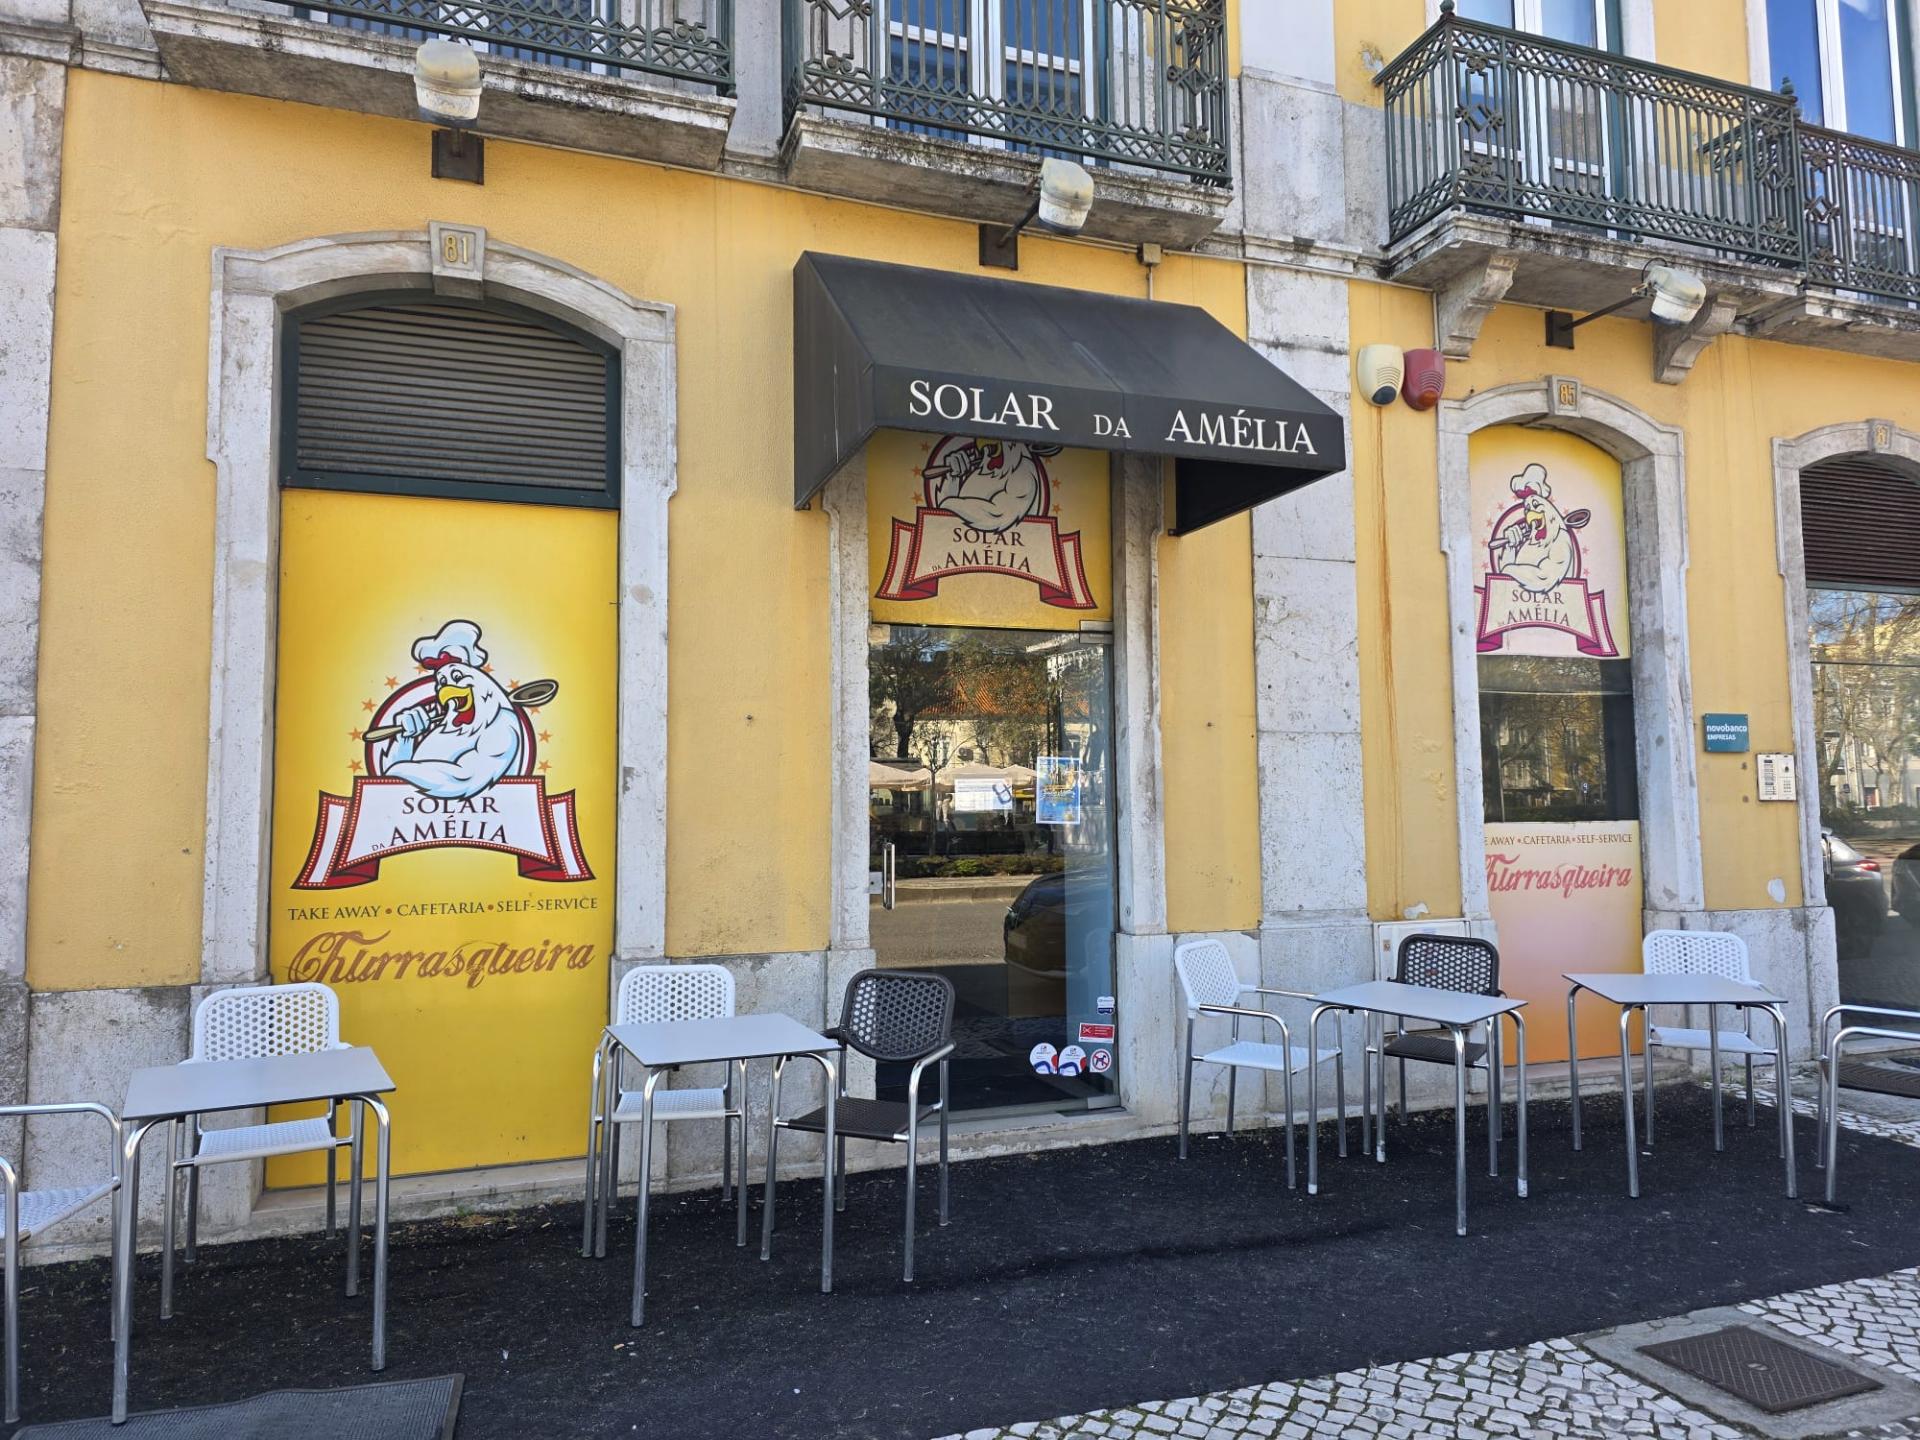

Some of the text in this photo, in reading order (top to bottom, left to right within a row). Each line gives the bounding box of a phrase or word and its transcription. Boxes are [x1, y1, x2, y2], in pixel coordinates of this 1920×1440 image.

[444, 235, 469, 264] 81
[1559, 384, 1576, 406] 85
[908, 379, 1318, 455] SOLAR DA AMÉLIA
[952, 527, 1025, 547] SOLAR
[944, 545, 1032, 573] AMÉLIA
[1511, 588, 1565, 605] SOLAR
[1506, 603, 1570, 627] AMÉLIA
[1706, 723, 1748, 733] novobanco
[402, 796, 500, 815] SOLAR
[371, 814, 510, 852] DA AMÉLIA
[1490, 835, 1516, 846] AWAY
[1522, 835, 1572, 845] CAFETARIA
[1576, 833, 1633, 844] SELF-SERVICE
[1485, 854, 1633, 898] hurrasqueira
[287, 896, 598, 921] TAKE AWAY CAFETARIA SELF-SERVICE
[287, 930, 596, 988] Churrasqueira
